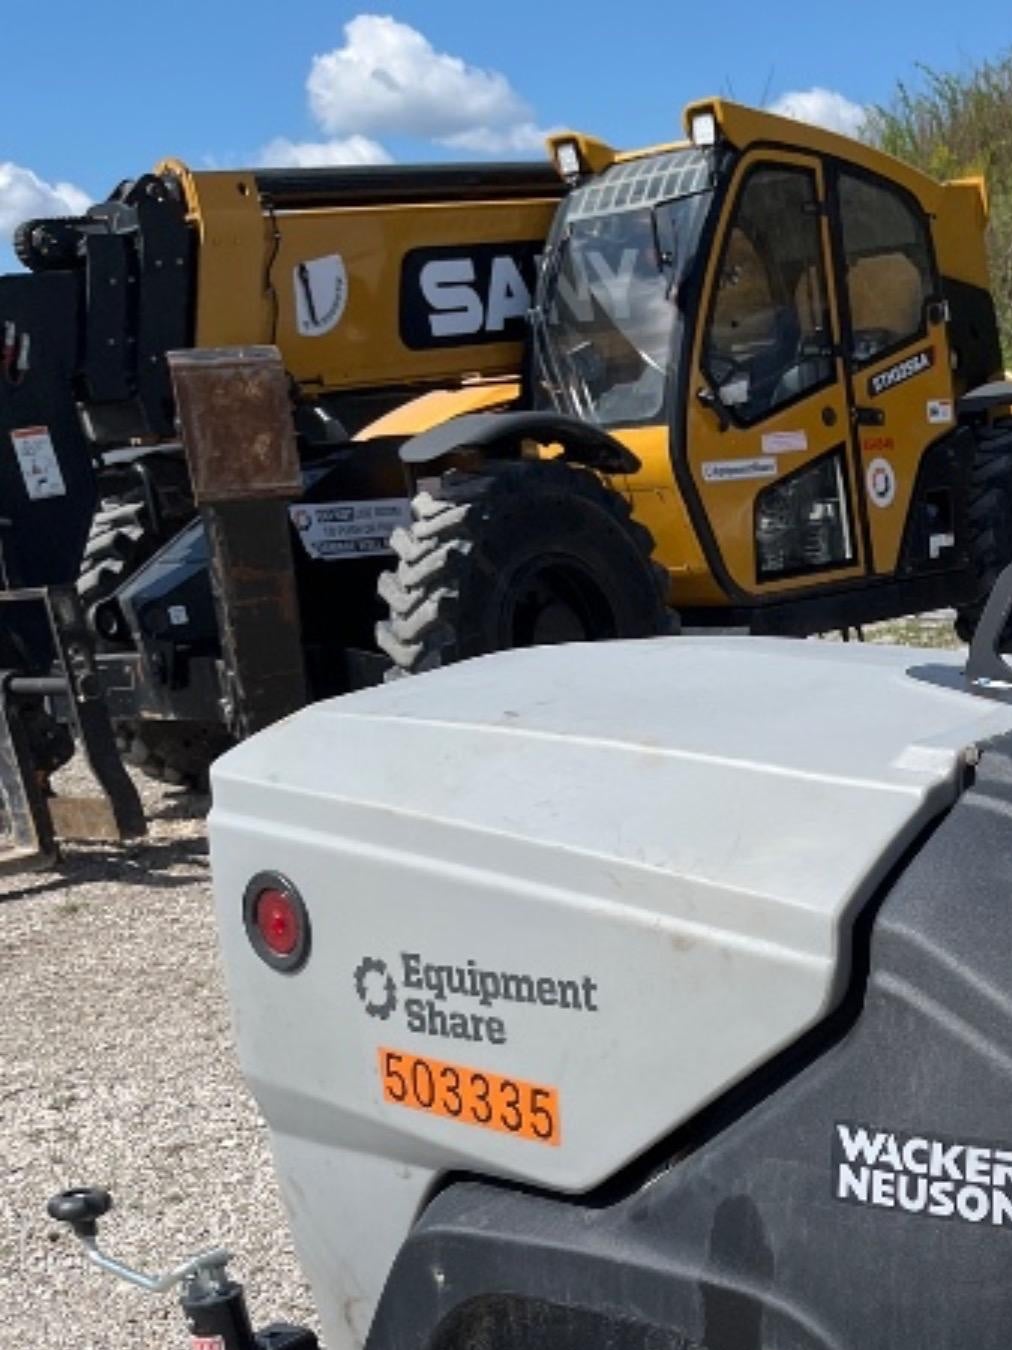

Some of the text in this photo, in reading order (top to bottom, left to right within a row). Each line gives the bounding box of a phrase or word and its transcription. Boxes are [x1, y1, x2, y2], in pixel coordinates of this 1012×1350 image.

[419, 249, 640, 337] SANY
[401, 952, 598, 1012] Equipment
[404, 998, 507, 1045] Share
[385, 1052, 554, 1142] 503335
